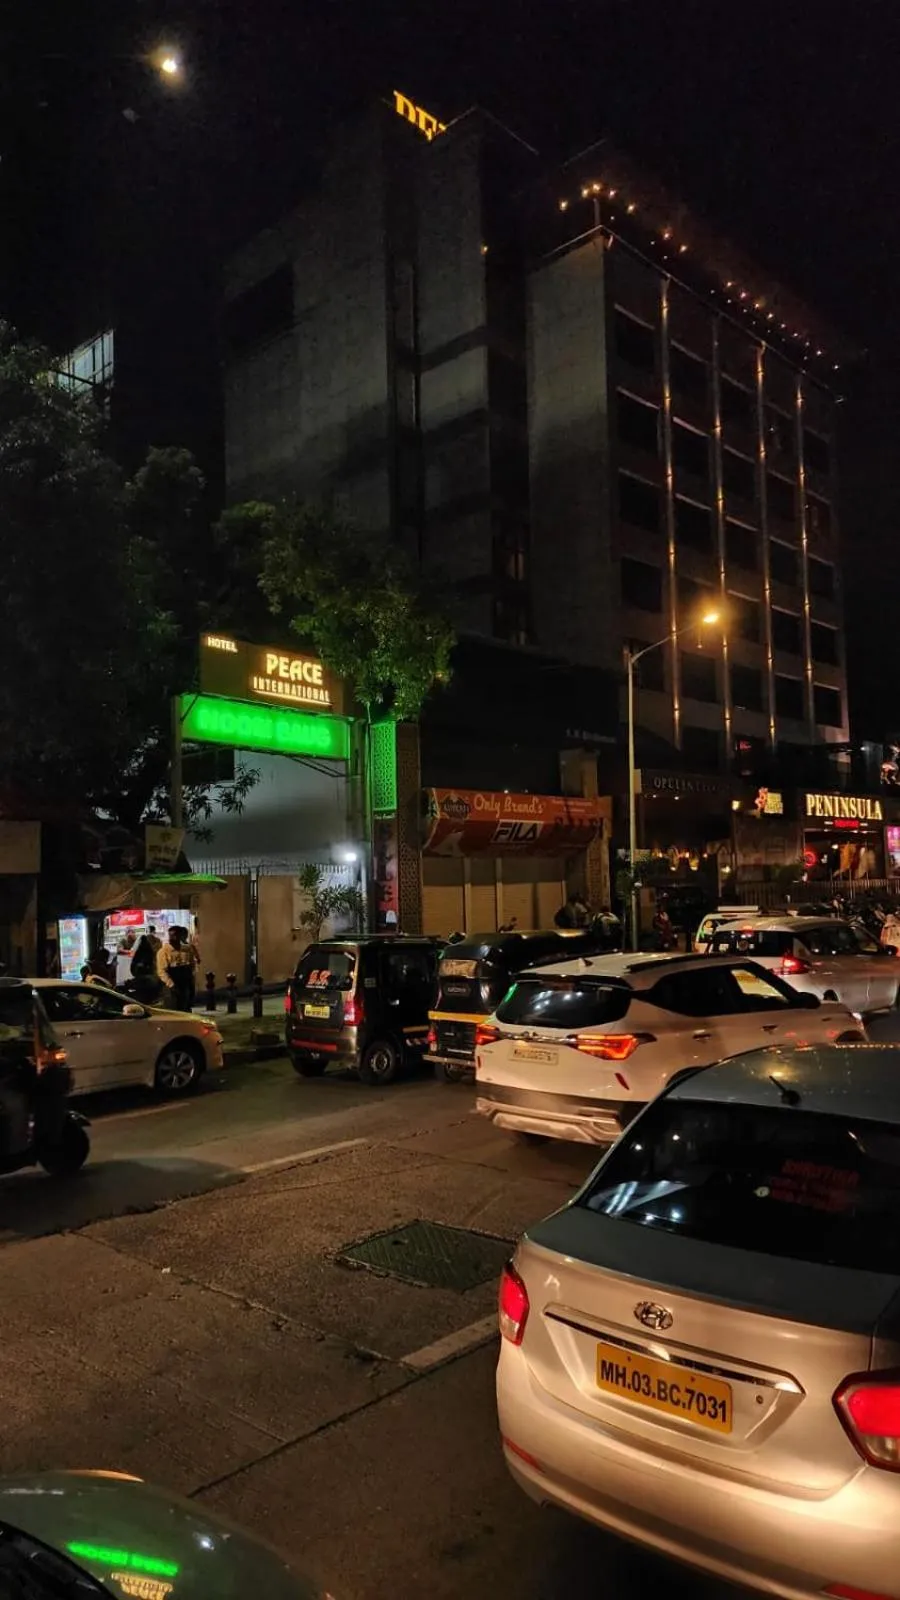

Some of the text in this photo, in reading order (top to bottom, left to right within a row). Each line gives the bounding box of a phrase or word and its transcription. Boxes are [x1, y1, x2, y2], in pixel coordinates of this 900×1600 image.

[207, 636, 238, 653] HOTEL
[266, 653, 323, 684] PEACE
[253, 676, 330, 702] INTERNATIONAL
[473, 793, 501, 818] Only
[805, 793, 883, 821] PENINSULA
[494, 821, 538, 841] FILA
[600, 1359, 728, 1424] MH.03.BC.7031
